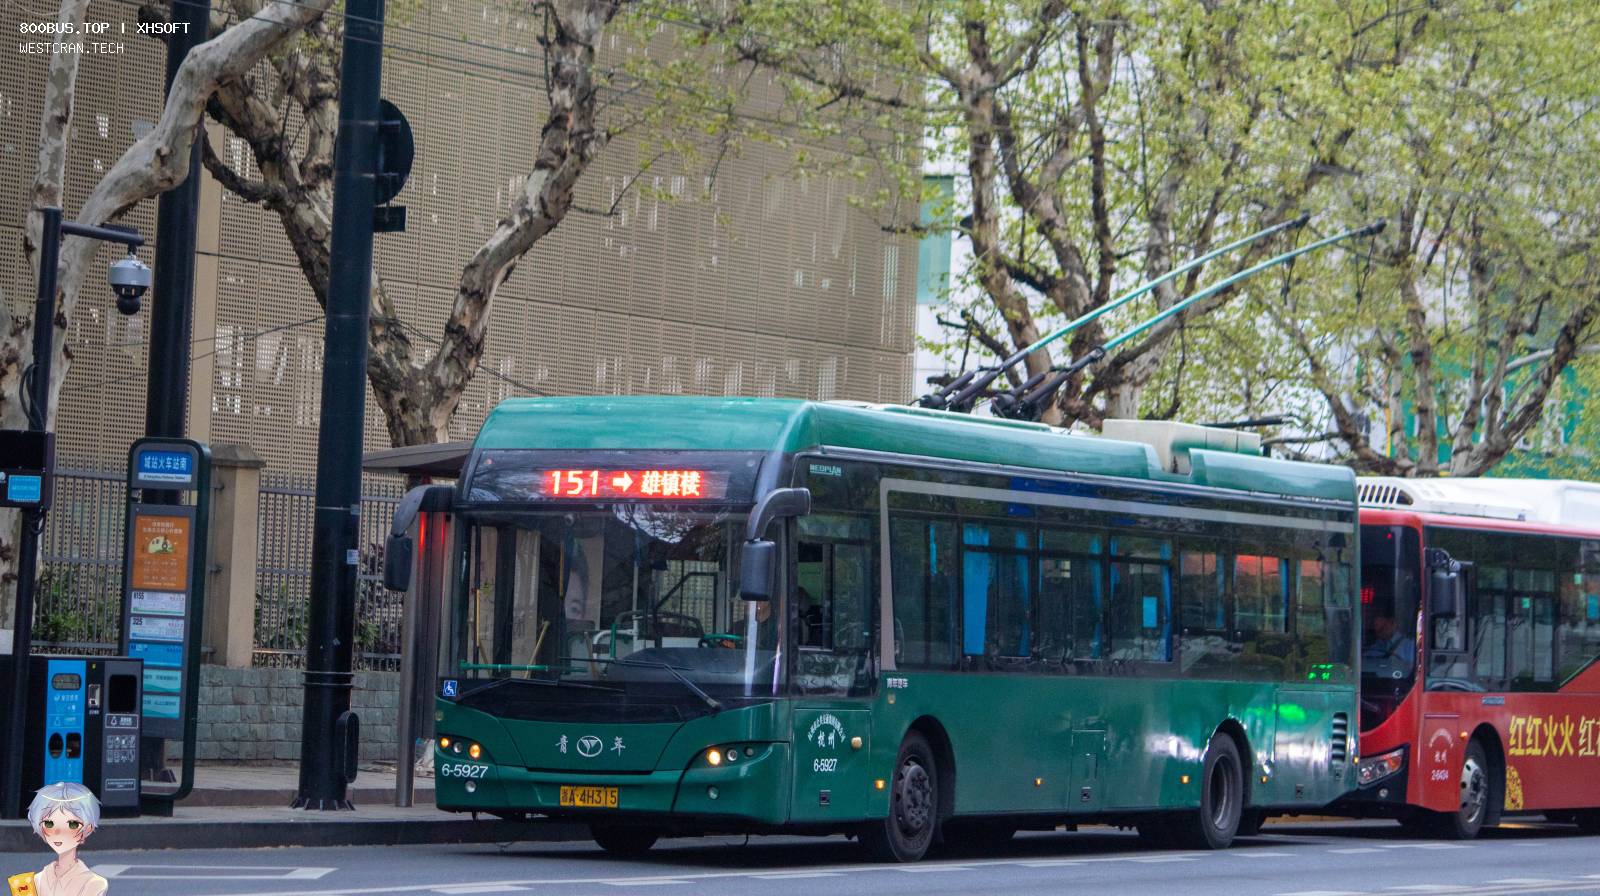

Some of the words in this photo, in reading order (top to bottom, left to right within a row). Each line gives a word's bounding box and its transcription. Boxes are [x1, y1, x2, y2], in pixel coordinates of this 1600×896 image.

[144, 455, 188, 471] 城站火车站南
[551, 470, 599, 495] 151
[640, 470, 701, 496] 雄镇楼
[1508, 714, 1575, 757] 红红火火
[1578, 715, 1600, 757] 红
[441, 764, 489, 779] 6-5927
[814, 759, 837, 772] 6-5927
